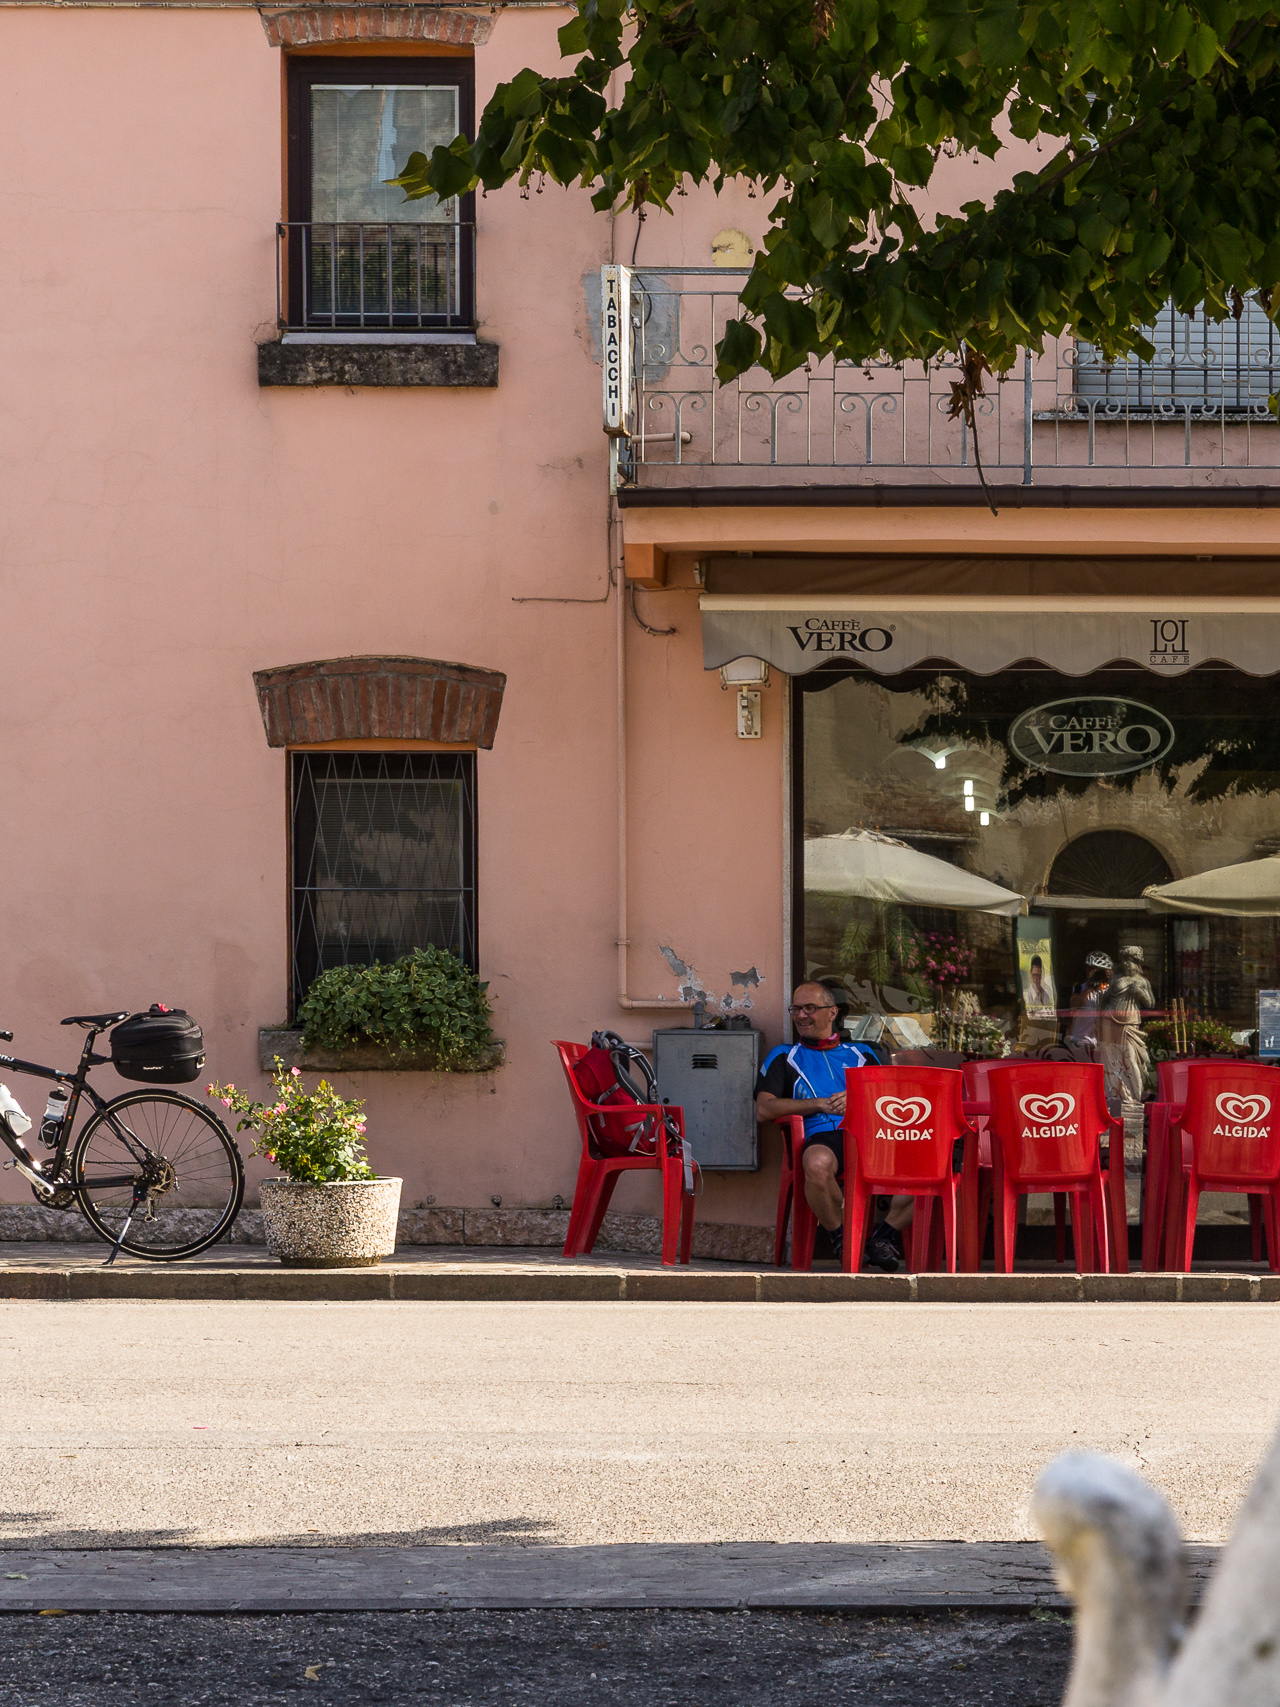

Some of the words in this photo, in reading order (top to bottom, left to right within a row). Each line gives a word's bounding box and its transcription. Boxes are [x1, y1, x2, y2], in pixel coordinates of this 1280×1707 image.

[606, 279, 619, 417] TABACCHI
[804, 618, 861, 631] CAFFÈ
[785, 626, 894, 653] VERO
[1149, 655, 1190, 663] CAFE
[1049, 714, 1120, 731] CAFFÈ
[1024, 724, 1161, 755] VERO
[875, 1127, 932, 1141] ALGIDA
[1021, 1124, 1078, 1139] ALGIDA
[1213, 1124, 1269, 1139] ALGIDA
